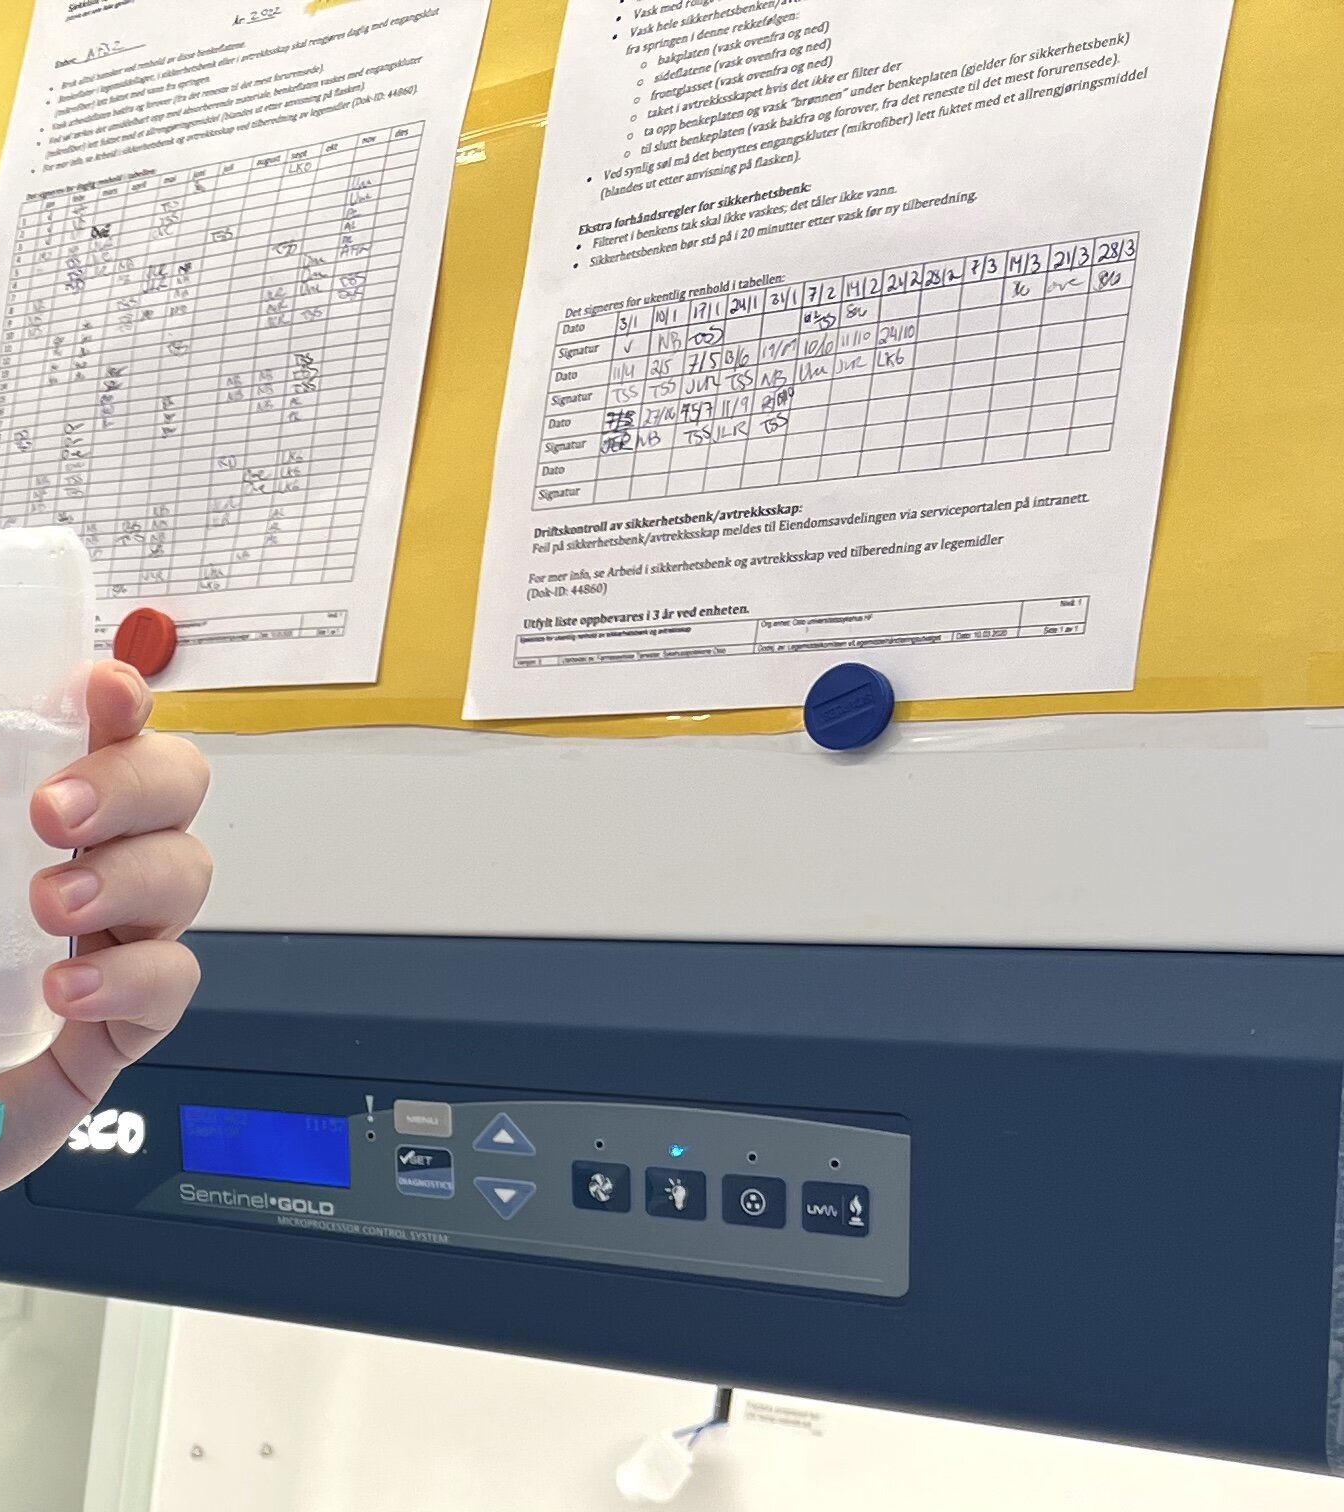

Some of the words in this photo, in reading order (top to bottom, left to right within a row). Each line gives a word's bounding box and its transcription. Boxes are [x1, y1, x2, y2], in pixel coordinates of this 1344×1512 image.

[604, 167, 623, 180] Ved
[624, 162, 655, 178] synlig
[656, 157, 672, 170] søl
[673, 153, 690, 166] må
[692, 151, 710, 163] det
[712, 143, 758, 159] benyttes
[760, 128, 839, 150] engangskluter
[841, 113, 913, 137] (mikrofiber)
[916, 110, 936, 121] lett
[938, 102, 972, 117] fuktet
[975, 95, 1001, 109] med
[1003, 93, 1016, 104] et
[1018, 69, 1147, 101] allrengjøringsmiddel
[578, 222, 612, 234] Ekstra
[614, 205, 696, 228] forhåndsregler
[698, 201, 716, 212] for
[717, 183, 811, 208] sikkerhetsbenk:
[1098, 238, 1136, 263] 28/3
[972, 259, 997, 275] 7/3
[808, 285, 836, 300] 7/2
[562, 323, 585, 335] Dato
[558, 343, 600, 360] Signatur
[688, 351, 720, 372] 7/5
[555, 371, 578, 382] Dato
[552, 391, 593, 407] Signatur
[548, 418, 571, 428] Dato
[545, 439, 587, 454] Signatur
[542, 465, 565, 477] Dato
[538, 487, 580, 501] Signatur
[532, 542, 551, 553] Feil
[552, 540, 565, 555] på
[567, 529, 719, 550] sikkerhetsbenk/avtrekksskap
[722, 523, 762, 536] meldes
[764, 520, 776, 533] til
[779, 512, 896, 531] Eiendomsavdelingen
[899, 509, 918, 520] via
[920, 501, 1012, 518] serviceportalen
[1013, 497, 1030, 513] på
[1032, 494, 1089, 508] intranett.
[534, 521, 608, 538] Driftskontroll
[609, 522, 624, 531] av
[625, 505, 802, 529] sikkerhetsbenk/avtrekksskap:
[528, 573, 547, 583] For
[547, 573, 568, 582] mer
[569, 569, 591, 581] info,
[593, 570, 605, 578] se
[607, 564, 643, 577] Arbeid
[644, 564, 649, 574] i
[651, 557, 731, 573] sikkerhetsbenk
[734, 558, 748, 569] og
[750, 550, 824, 565] avtrekksskap
[827, 546, 848, 559] ved
[850, 542, 922, 557] tilberedning
[924, 542, 939, 551] av
[941, 535, 1004, 552] legemidler
[407, 1115, 438, 1126] MENU
[68, 1109, 146, 1153] SCO
[409, 1155, 433, 1166] SET
[398, 1177, 453, 1190] DIAGNOSTICS
[277, 1215, 360, 1234] MICROPROCESSOR
[362, 1223, 407, 1240] CONTROL
[409, 1228, 448, 1244] SYSTEM
